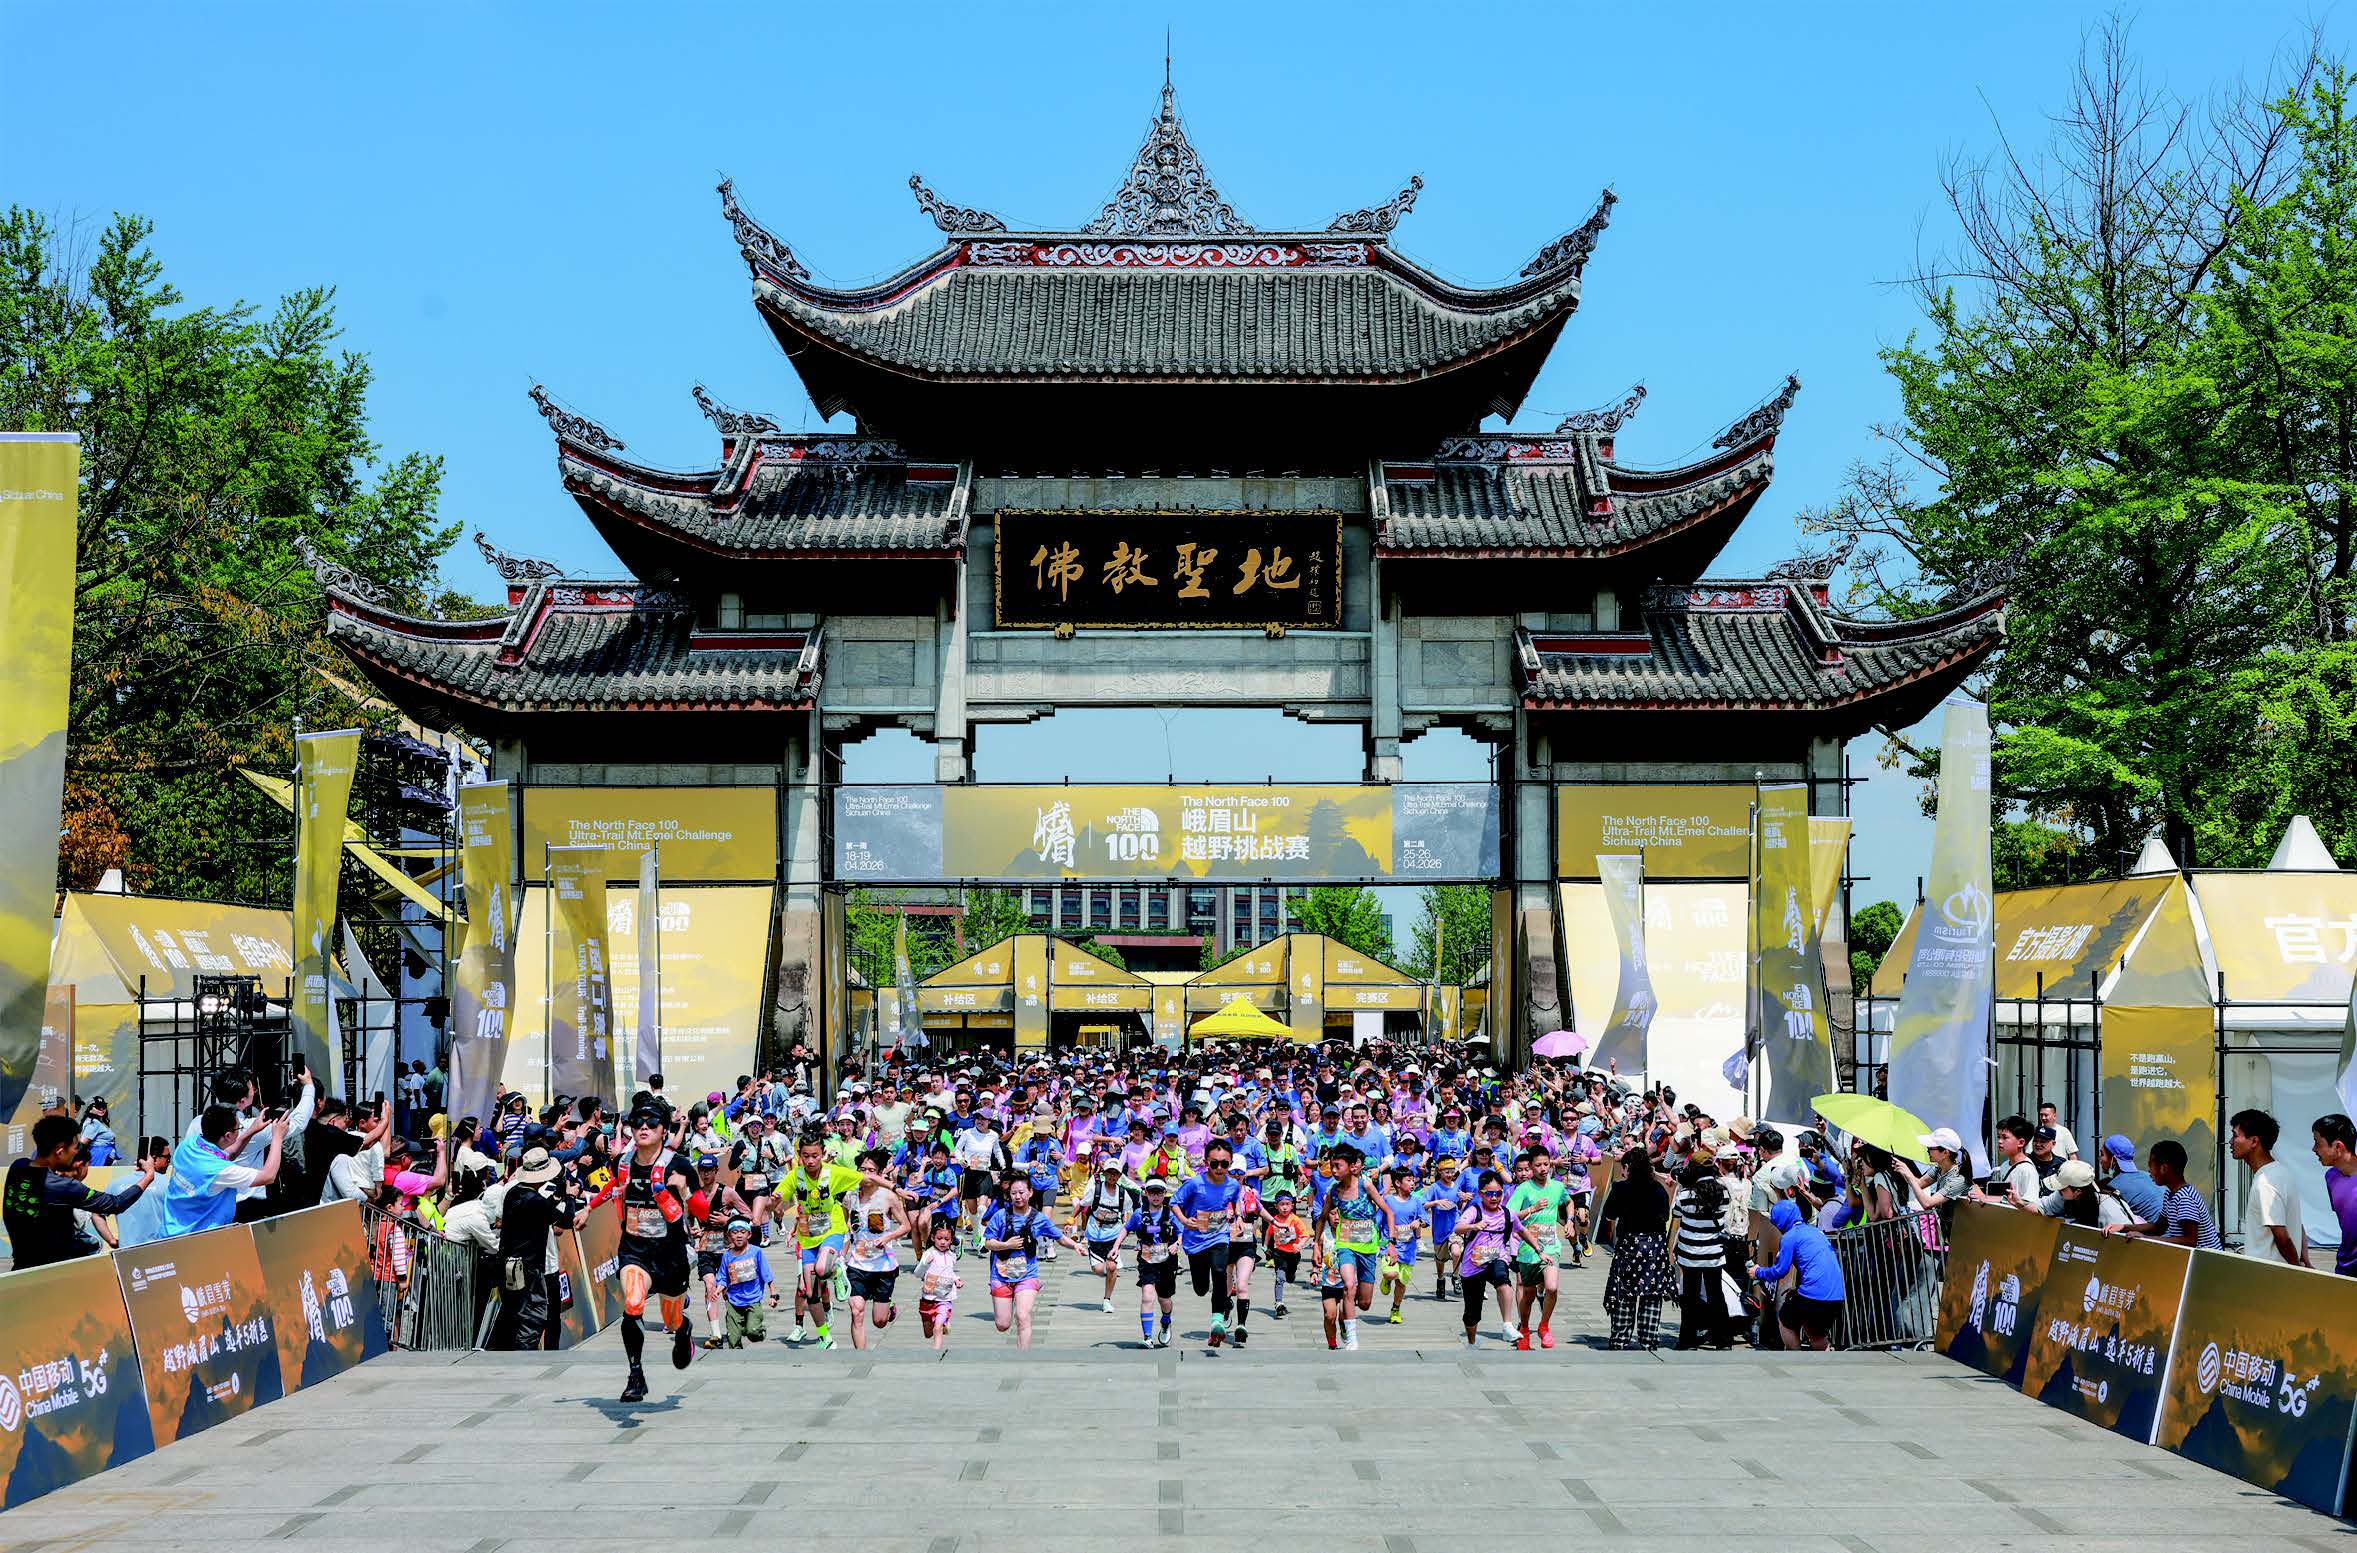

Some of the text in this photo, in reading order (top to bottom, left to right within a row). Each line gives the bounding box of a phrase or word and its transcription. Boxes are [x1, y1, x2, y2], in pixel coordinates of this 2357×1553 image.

[1030, 541, 1301, 602] 佛教聖地
[1182, 796, 1290, 807] The North Face 100
[1122, 808, 1141, 816] THE
[569, 820, 679, 830] The North Face 100
[1106, 816, 1141, 824] NORTH
[1182, 808, 1257, 833] 峨眉山
[1602, 816, 1710, 826] The North Face 100
[1116, 824, 1141, 832] FACE
[1602, 826, 1750, 836] Ultra-Trail Mt.Emei Challen
[569, 830, 732, 842] Ultra-Trail Mt.Emei Challenge
[1602, 836, 1682, 846] Sichuan China
[617, 841, 650, 850] China
[1105, 833, 1159, 861] 100
[1182, 835, 1310, 861] 越野挑战赛
[845, 851, 871, 860] 18-19
[1403, 849, 1431, 859] 25-26
[845, 860, 884, 871] 04.2026
[1403, 859, 1442, 869] 04.2026
[661, 916, 690, 931] 00
[943, 993, 976, 1006] 补给区
[1086, 993, 1119, 1005] 补给区
[1355, 992, 1389, 1003] 完赛区
[477, 1008, 504, 1038] 100
[331, 1296, 354, 1329] 100
[1994, 1301, 2017, 1336] 100
[2223, 1348, 2277, 1387] 中国移动
[18, 1357, 75, 1396] 中国移动
[2220, 1378, 2271, 1409] China Mobile
[25, 1387, 80, 1418] China Mobile
